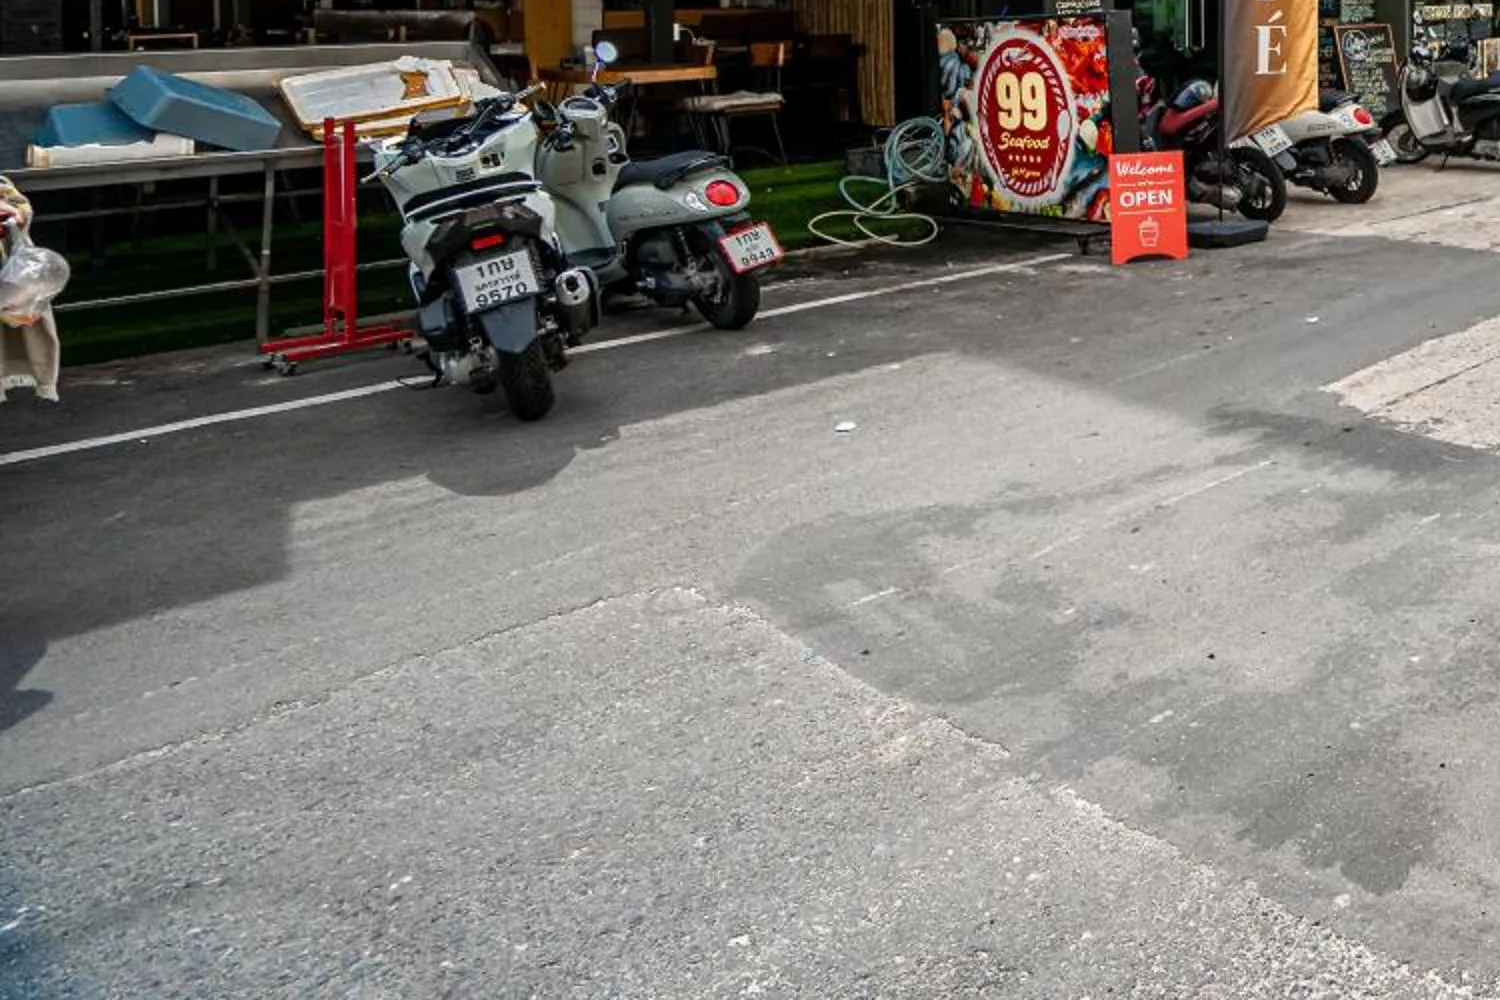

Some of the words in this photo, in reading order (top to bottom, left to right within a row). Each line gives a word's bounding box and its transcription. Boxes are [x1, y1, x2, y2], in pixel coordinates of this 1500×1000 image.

[996, 71, 1047, 131] 99
[998, 131, 1051, 149] Seafood
[1116, 160, 1177, 176] Welcome
[1119, 188, 1174, 208] OPEN
